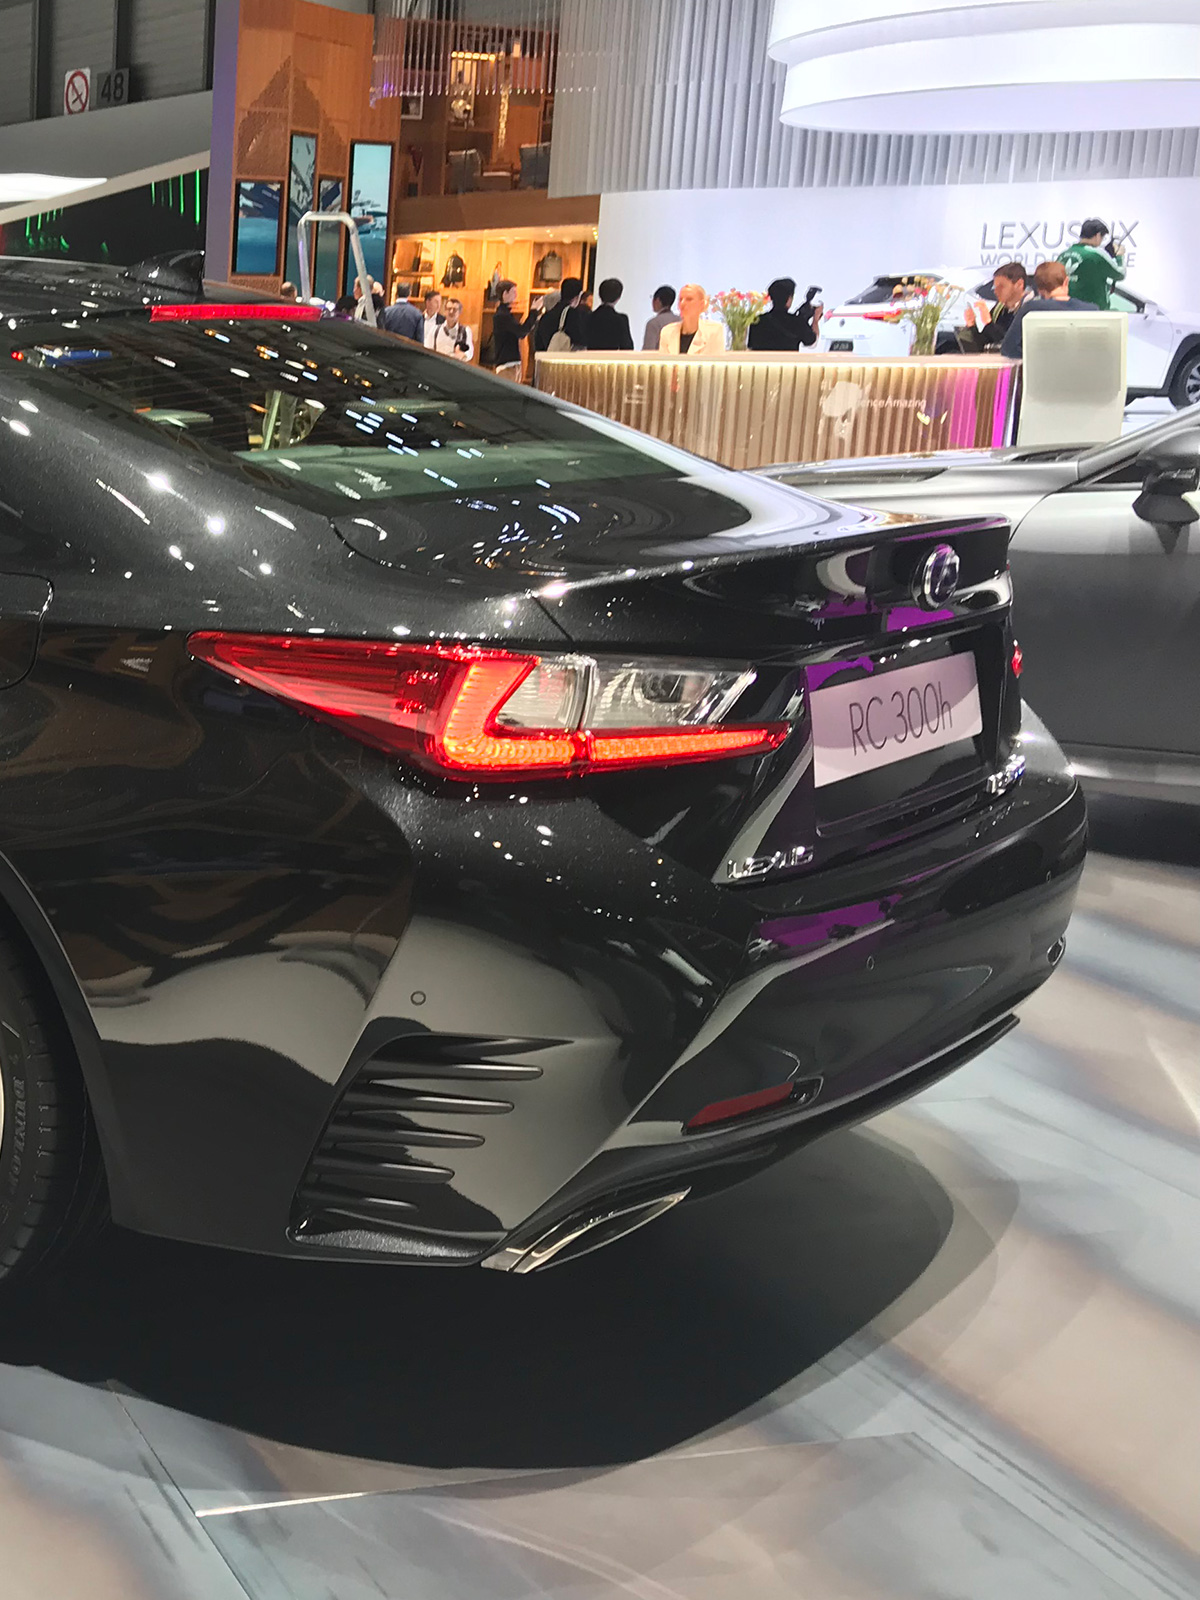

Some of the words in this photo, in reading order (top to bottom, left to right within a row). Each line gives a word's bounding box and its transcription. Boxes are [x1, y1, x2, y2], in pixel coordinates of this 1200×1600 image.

[101, 71, 124, 102] 48
[849, 696, 887, 756] RC
[890, 681, 953, 744] 300h
